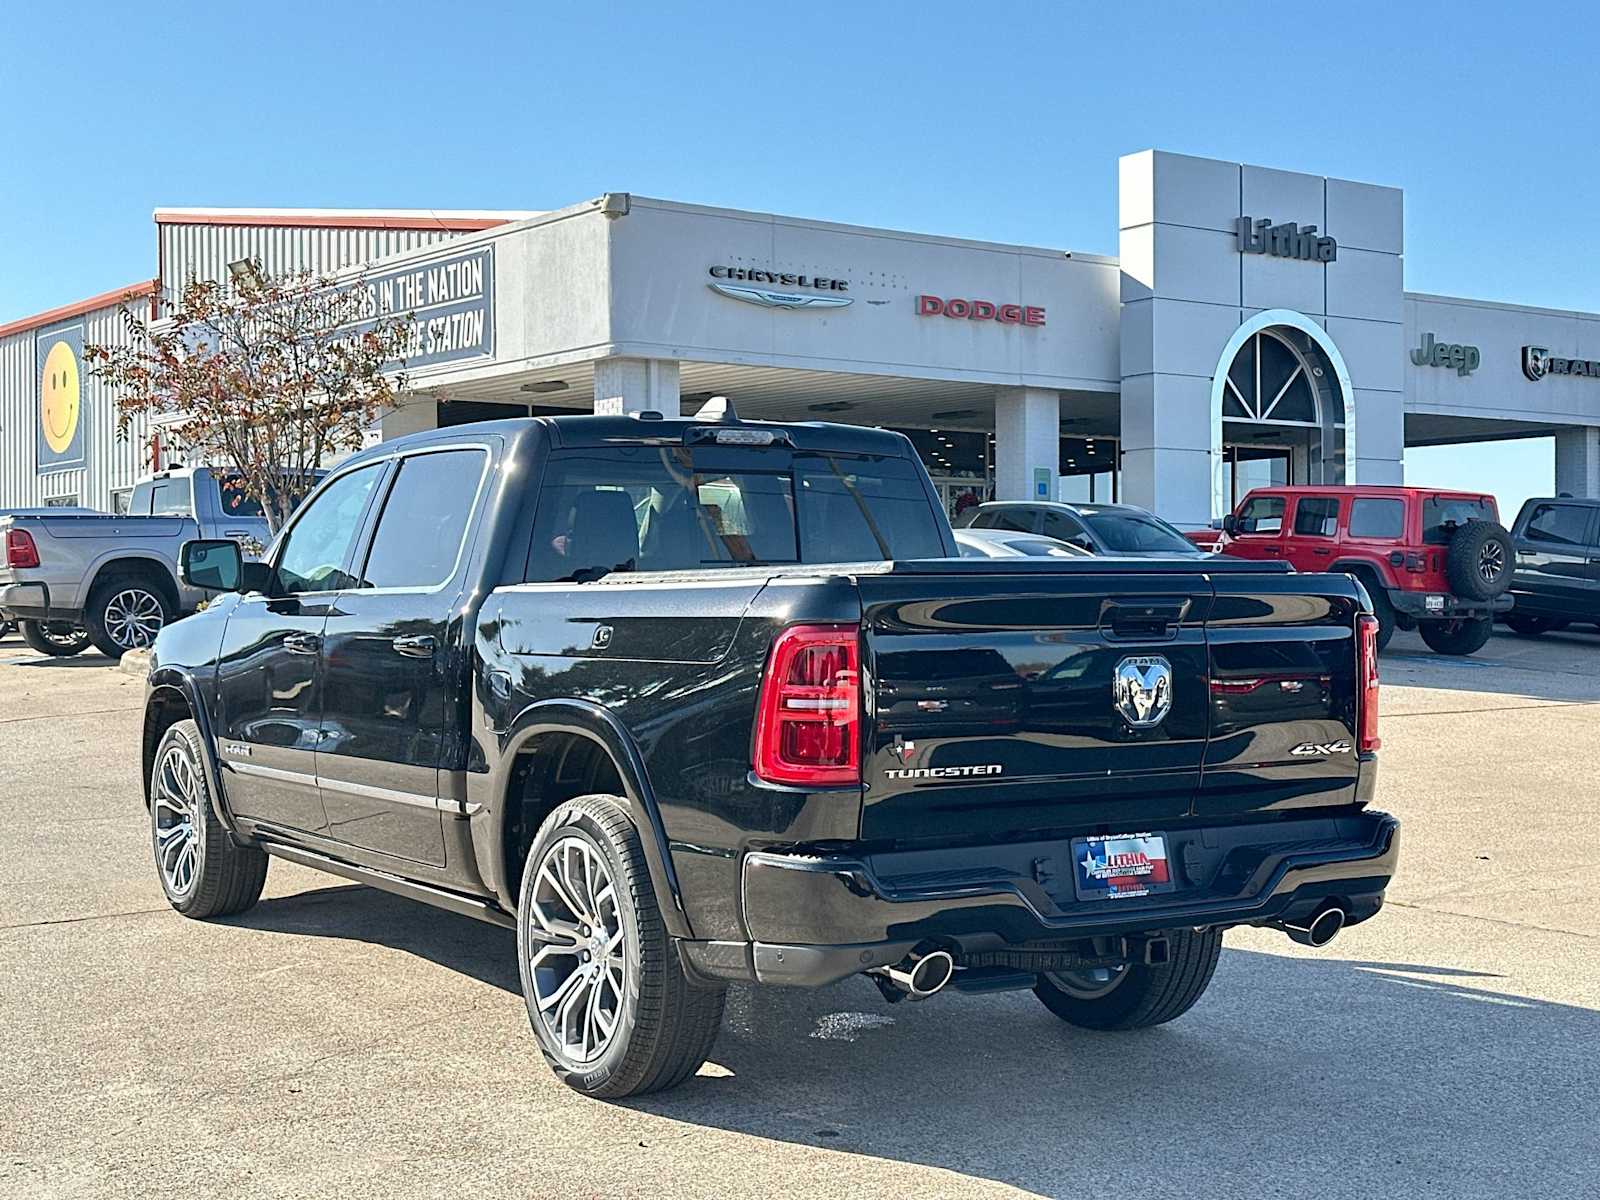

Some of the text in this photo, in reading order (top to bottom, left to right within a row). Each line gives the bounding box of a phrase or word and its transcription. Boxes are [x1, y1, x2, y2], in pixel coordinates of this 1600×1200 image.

[1235, 215, 1337, 262] Lithia
[379, 278, 394, 315] IN
[397, 271, 425, 308] THE
[428, 257, 483, 303] NATION
[708, 265, 850, 291] CHRYSLER
[915, 295, 1046, 327] DODGE
[427, 309, 484, 355] STATION
[1410, 332, 1480, 377] Jeep
[884, 764, 1003, 779] TUNGSTEN
[1108, 852, 1149, 868] LITHIA
